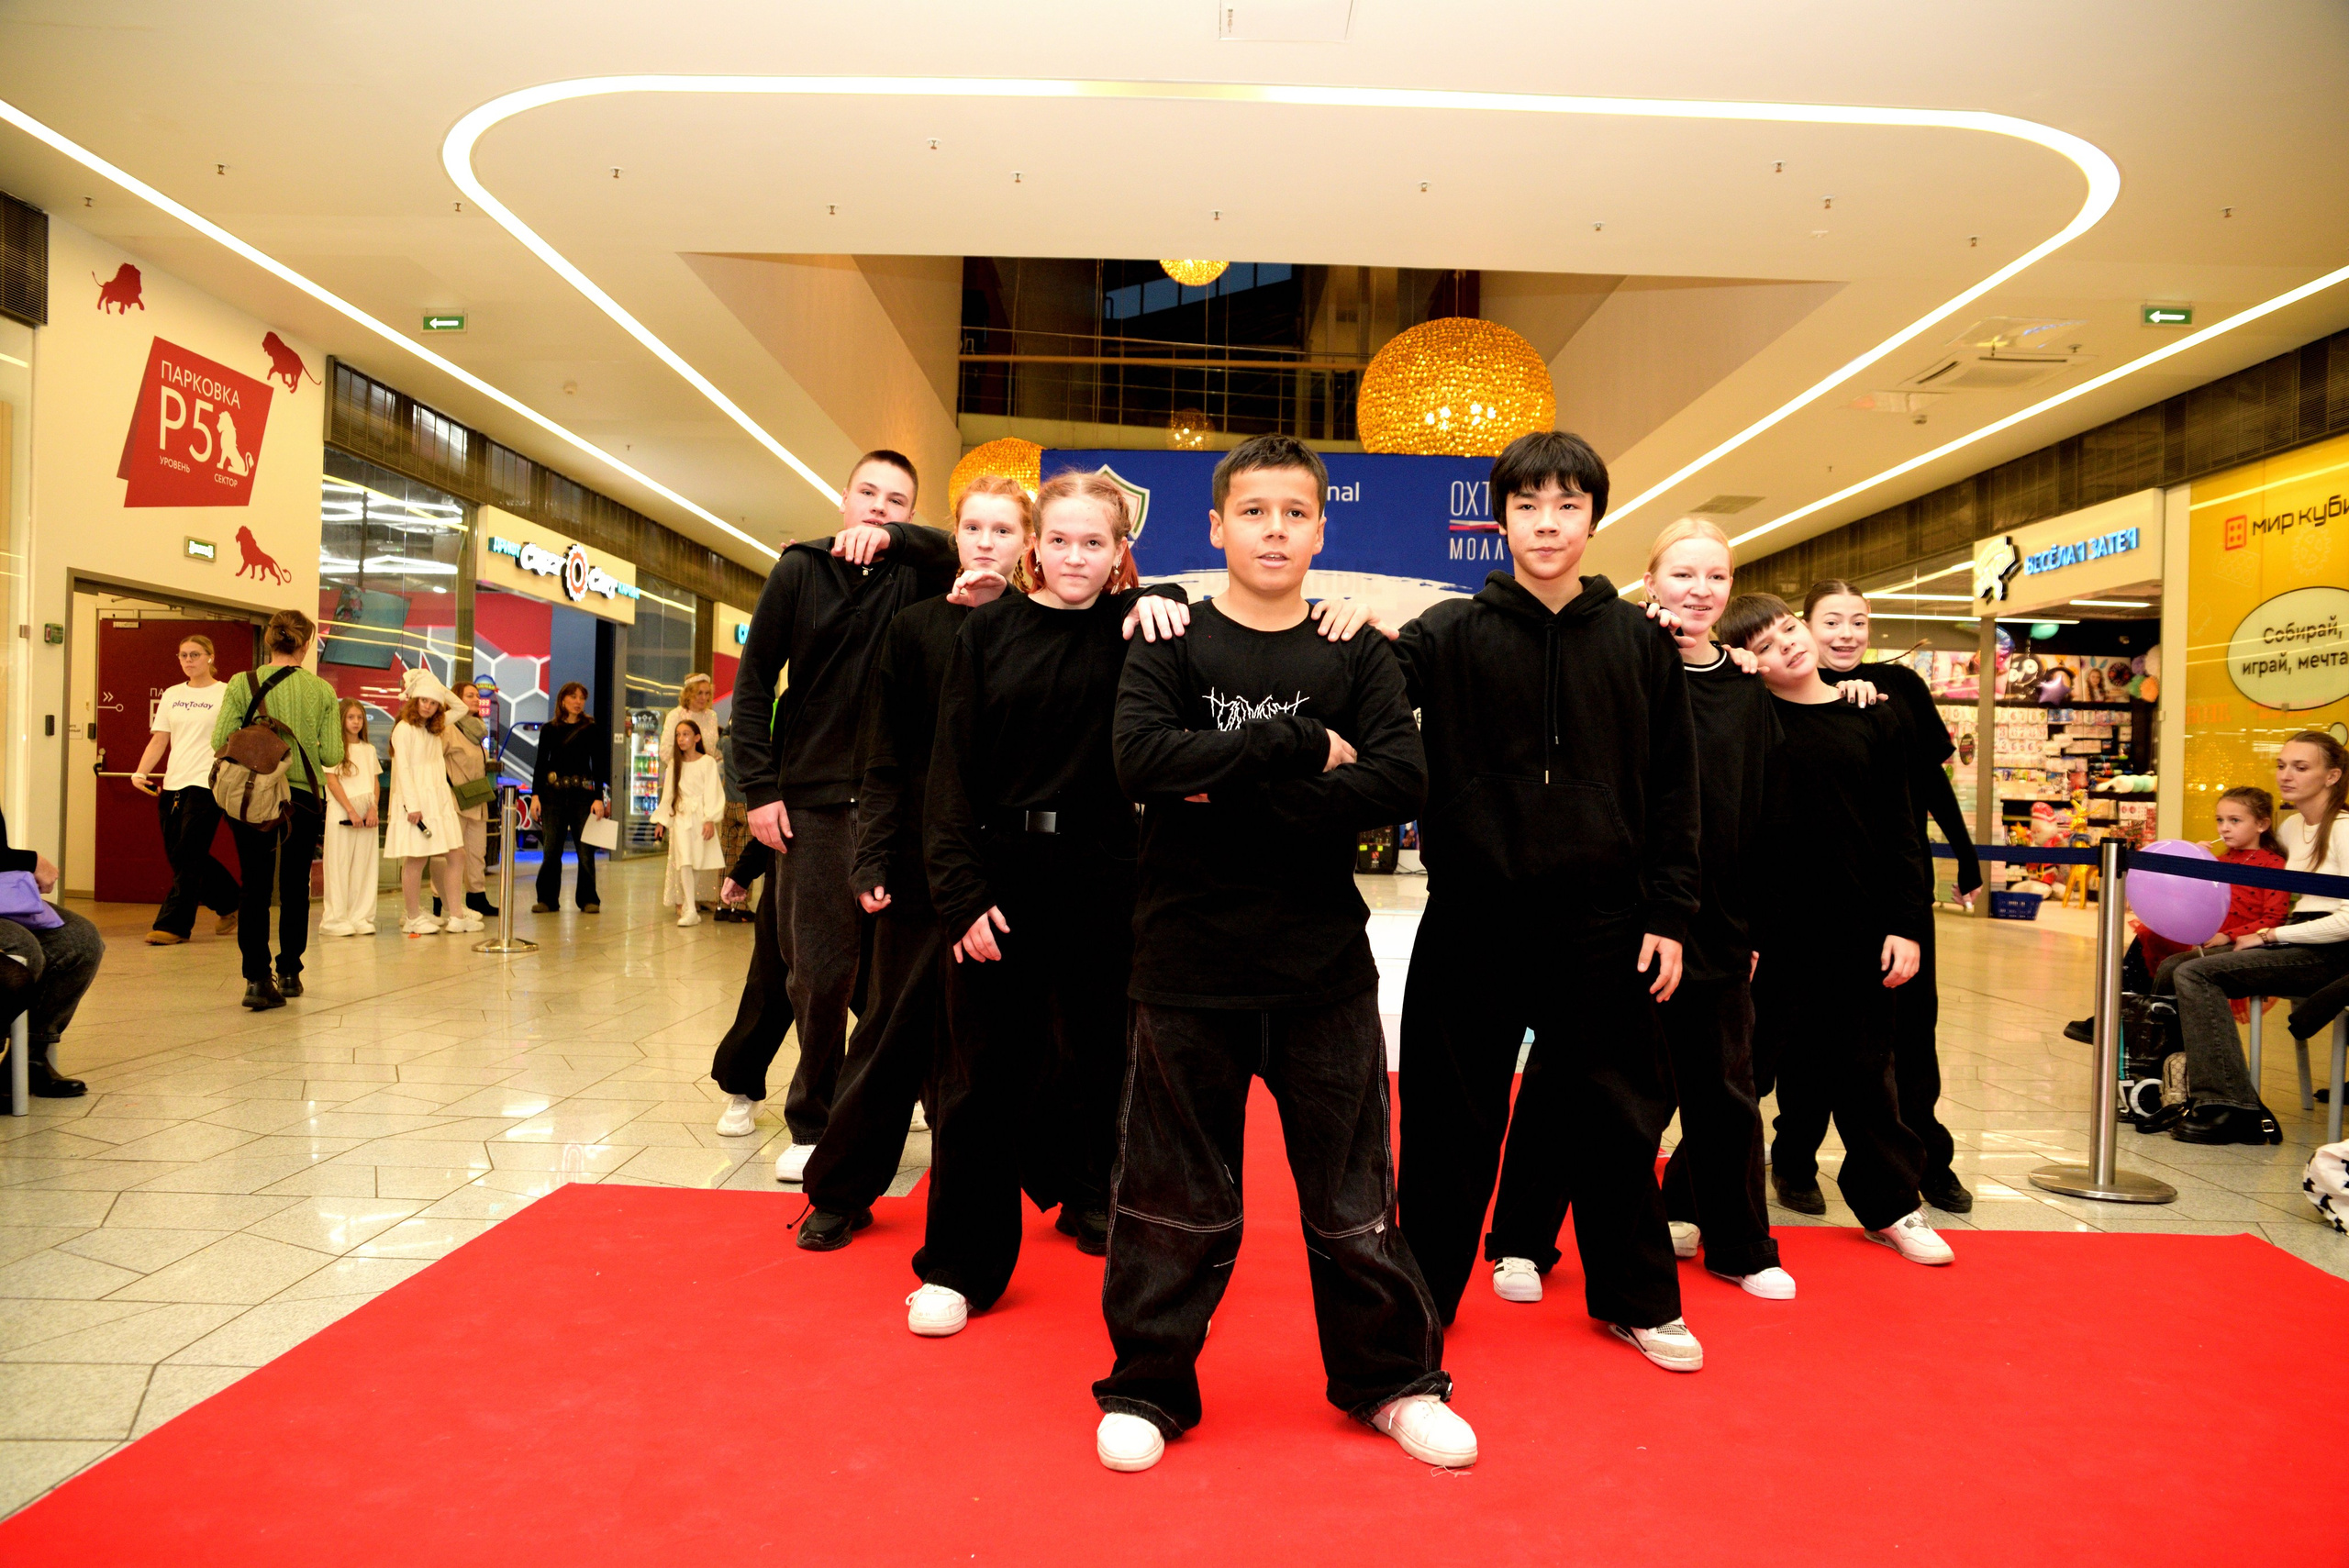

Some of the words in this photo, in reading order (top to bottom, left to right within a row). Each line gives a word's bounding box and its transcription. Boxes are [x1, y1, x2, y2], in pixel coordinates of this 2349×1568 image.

[161, 360, 240, 409] ПАРКОВКА
[159, 455, 191, 473] УРОВЕНЬ
[214, 473, 238, 488] СЕКТОР
[2024, 540, 2086, 575] ВЕСЁЛАЯ
[2087, 527, 2139, 560] ЗАТЕЯ
[2263, 615, 2343, 644] Собирай,
[2242, 652, 2292, 678] играй,
